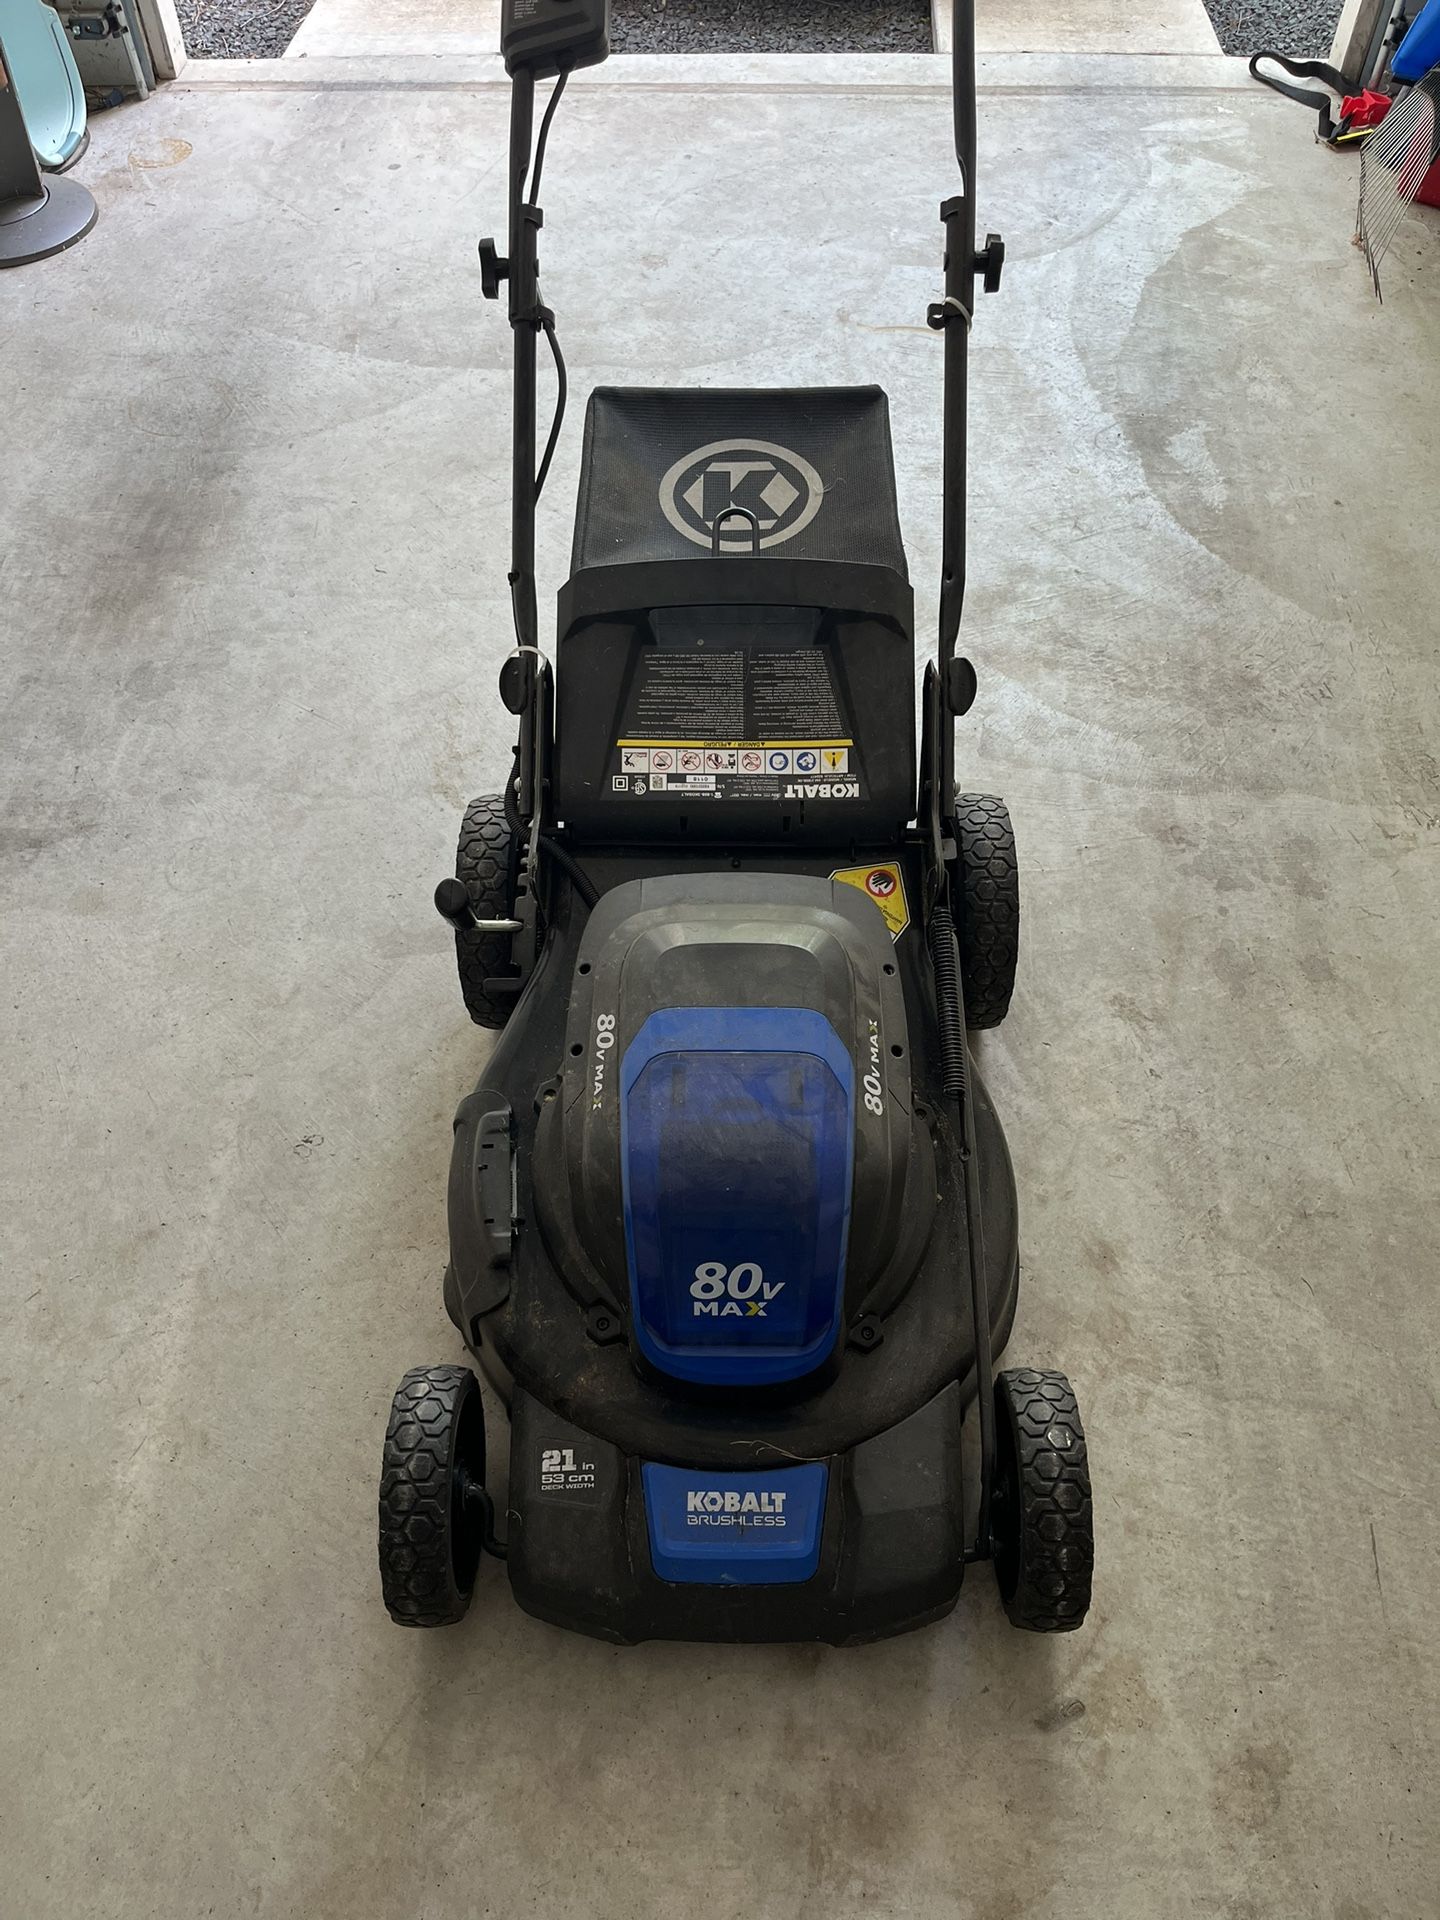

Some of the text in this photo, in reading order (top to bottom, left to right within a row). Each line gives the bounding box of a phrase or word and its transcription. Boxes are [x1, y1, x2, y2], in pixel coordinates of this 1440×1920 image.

[785, 783, 860, 799] KOBALT
[870, 1018, 879, 1064] MAX
[592, 1064, 606, 1111] MAX
[693, 1301, 768, 1317] MAX
[541, 1448, 595, 1473] 21 in
[541, 1473, 595, 1483] 53 cm
[565, 1482, 595, 1490] WIDTH
[686, 1491, 786, 1513] KOBALT
[686, 1514, 786, 1526] BRUSHLESS
